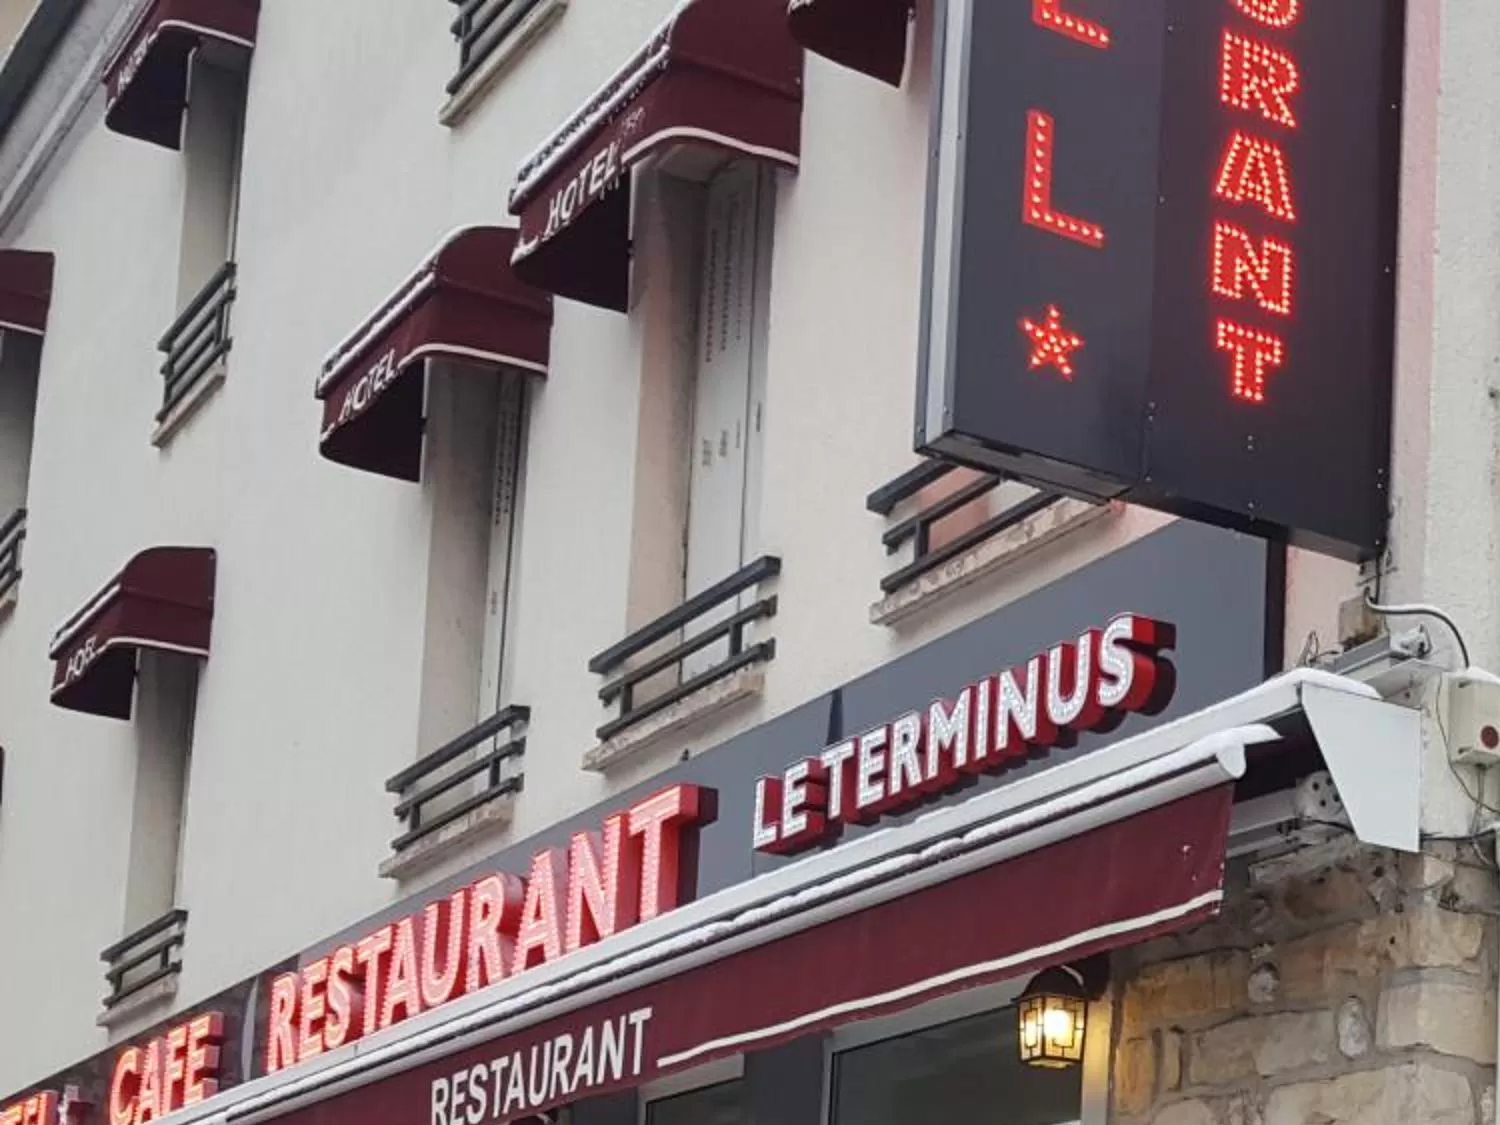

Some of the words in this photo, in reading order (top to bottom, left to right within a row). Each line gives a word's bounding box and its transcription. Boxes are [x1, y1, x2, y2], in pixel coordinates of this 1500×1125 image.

[543, 141, 618, 238] HOTEL
[753, 771, 811, 851] LE
[820, 612, 1140, 820] TERMINUS
[266, 783, 690, 1076] RESTAURANT
